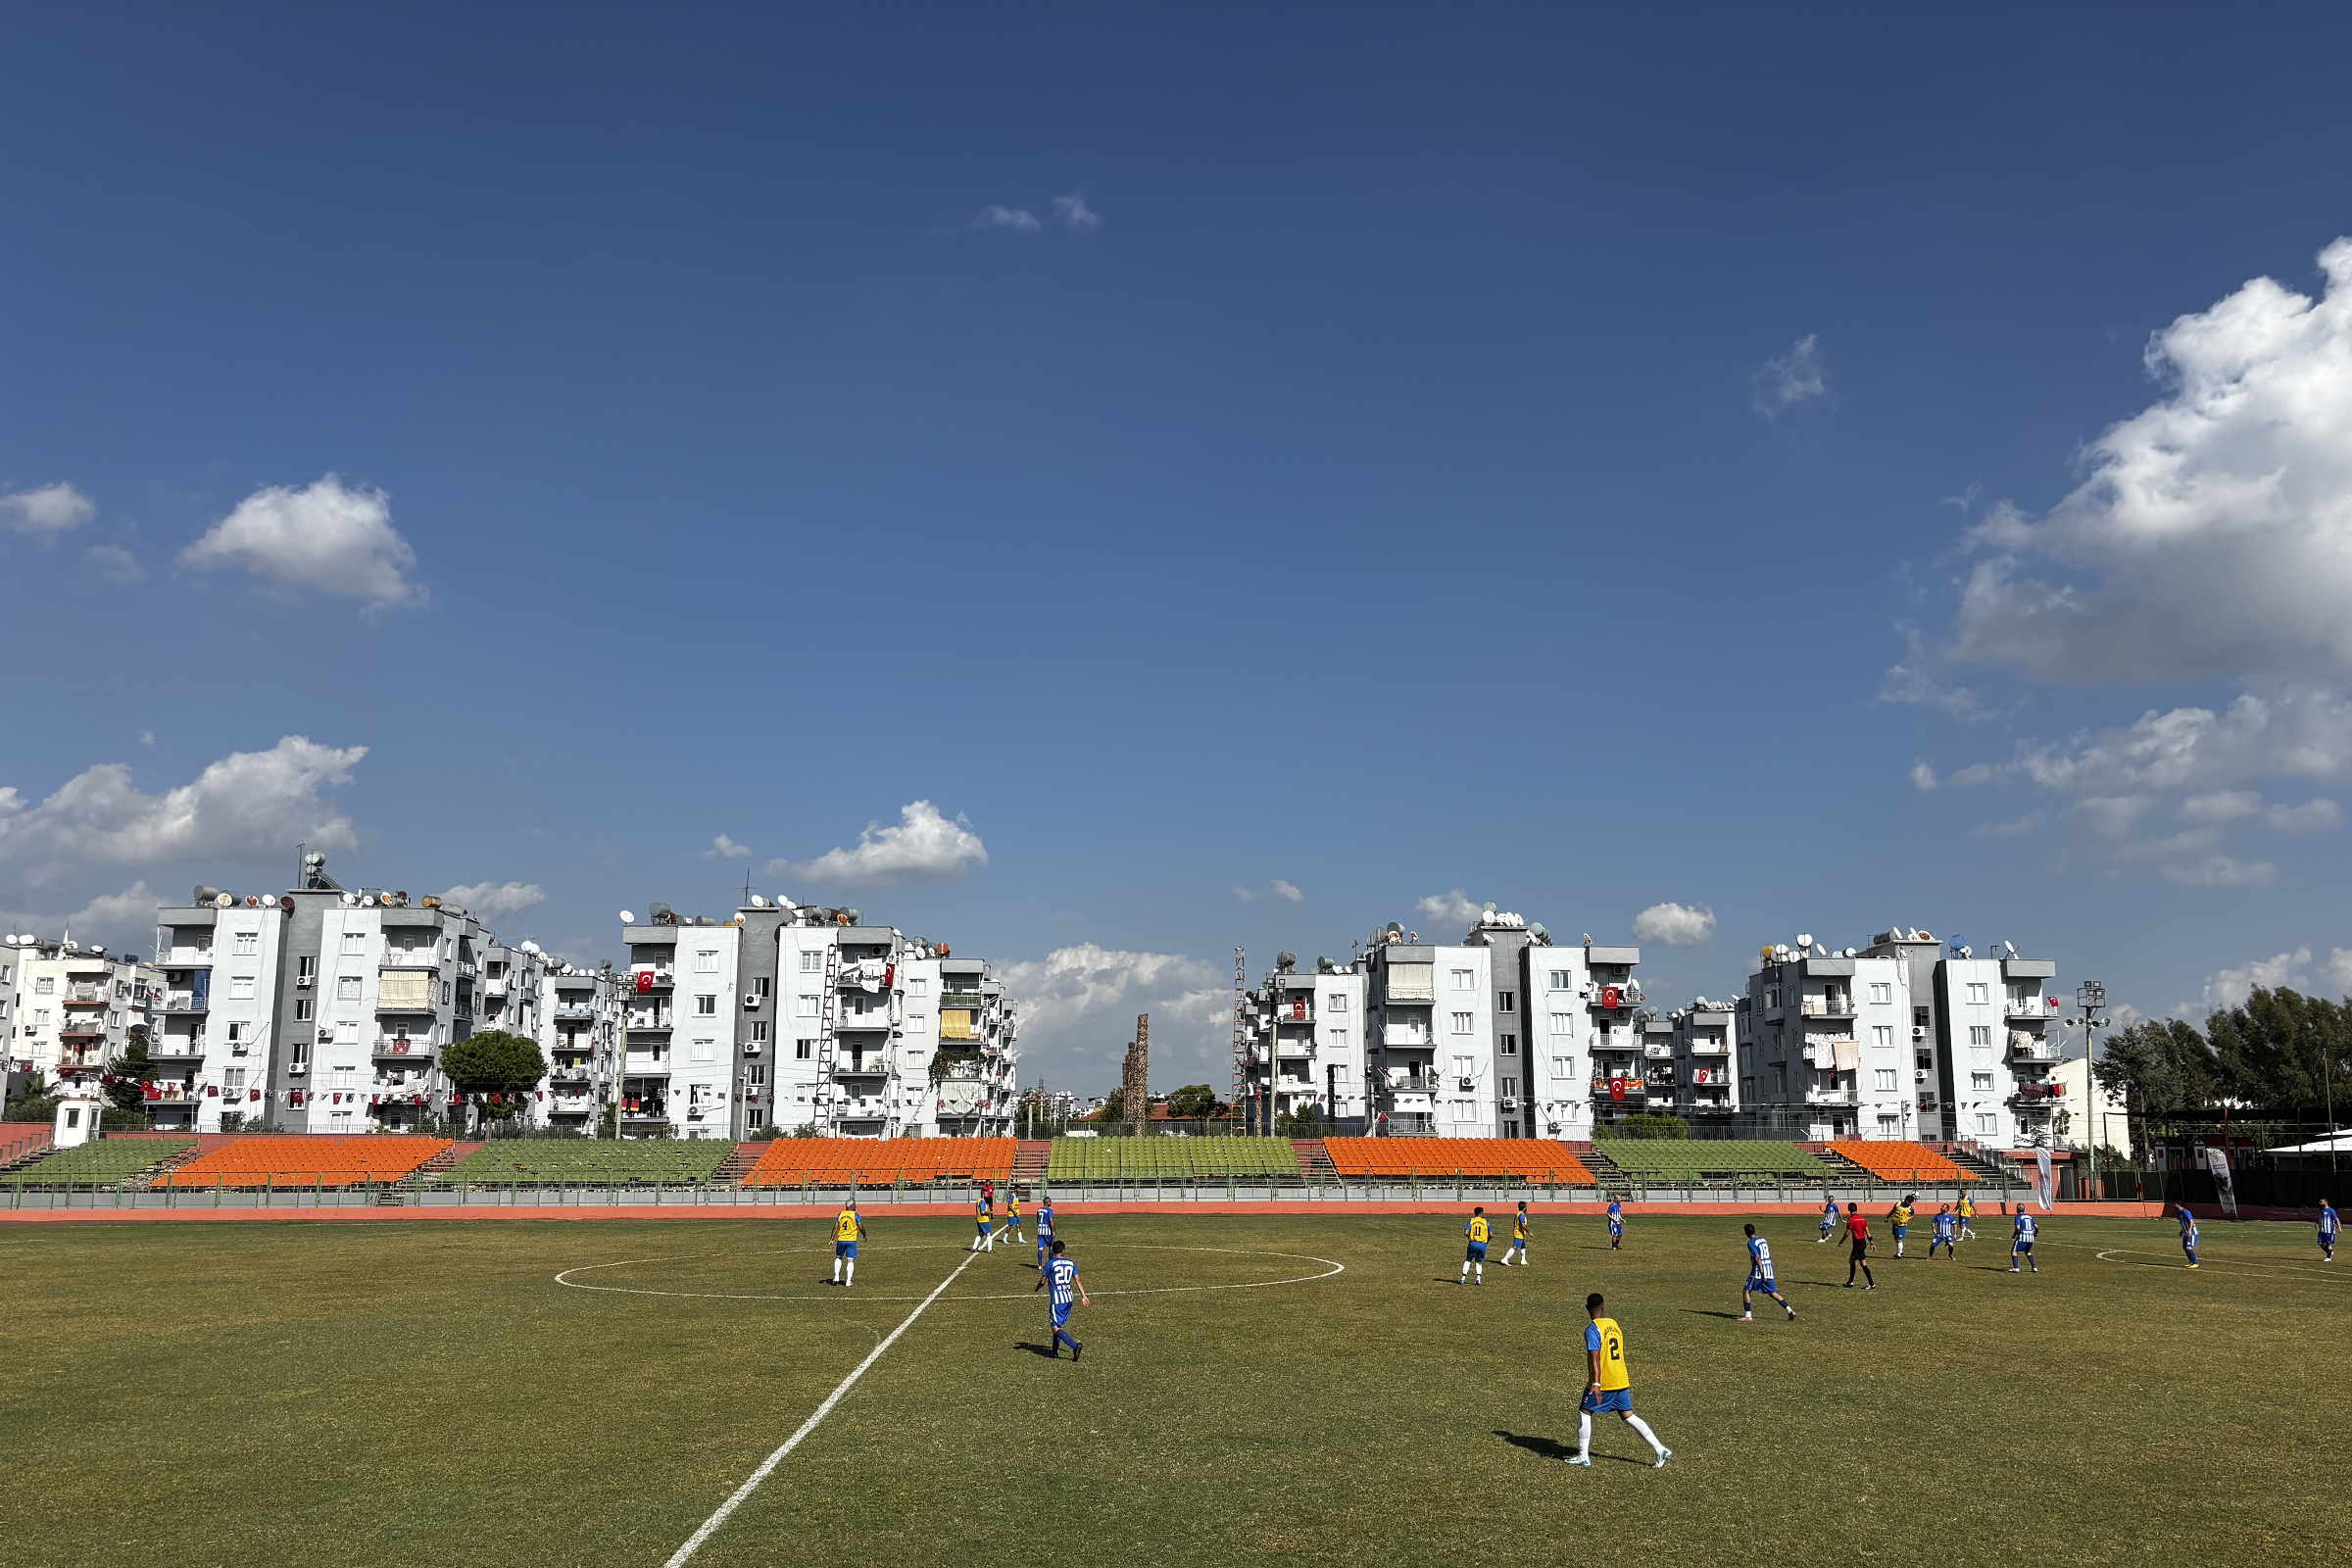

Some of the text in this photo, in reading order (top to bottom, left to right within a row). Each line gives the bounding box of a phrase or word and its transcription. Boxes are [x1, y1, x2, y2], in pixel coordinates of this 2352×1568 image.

[1039, 1212, 1044, 1223] 7
[842, 1221, 848, 1231] 4
[2025, 1219, 2032, 1230] 11
[1475, 1226, 1482, 1236] 11
[1759, 1243, 1770, 1260] 18
[1054, 1266, 1073, 1284] 20
[1609, 1338, 1620, 1360] 2
